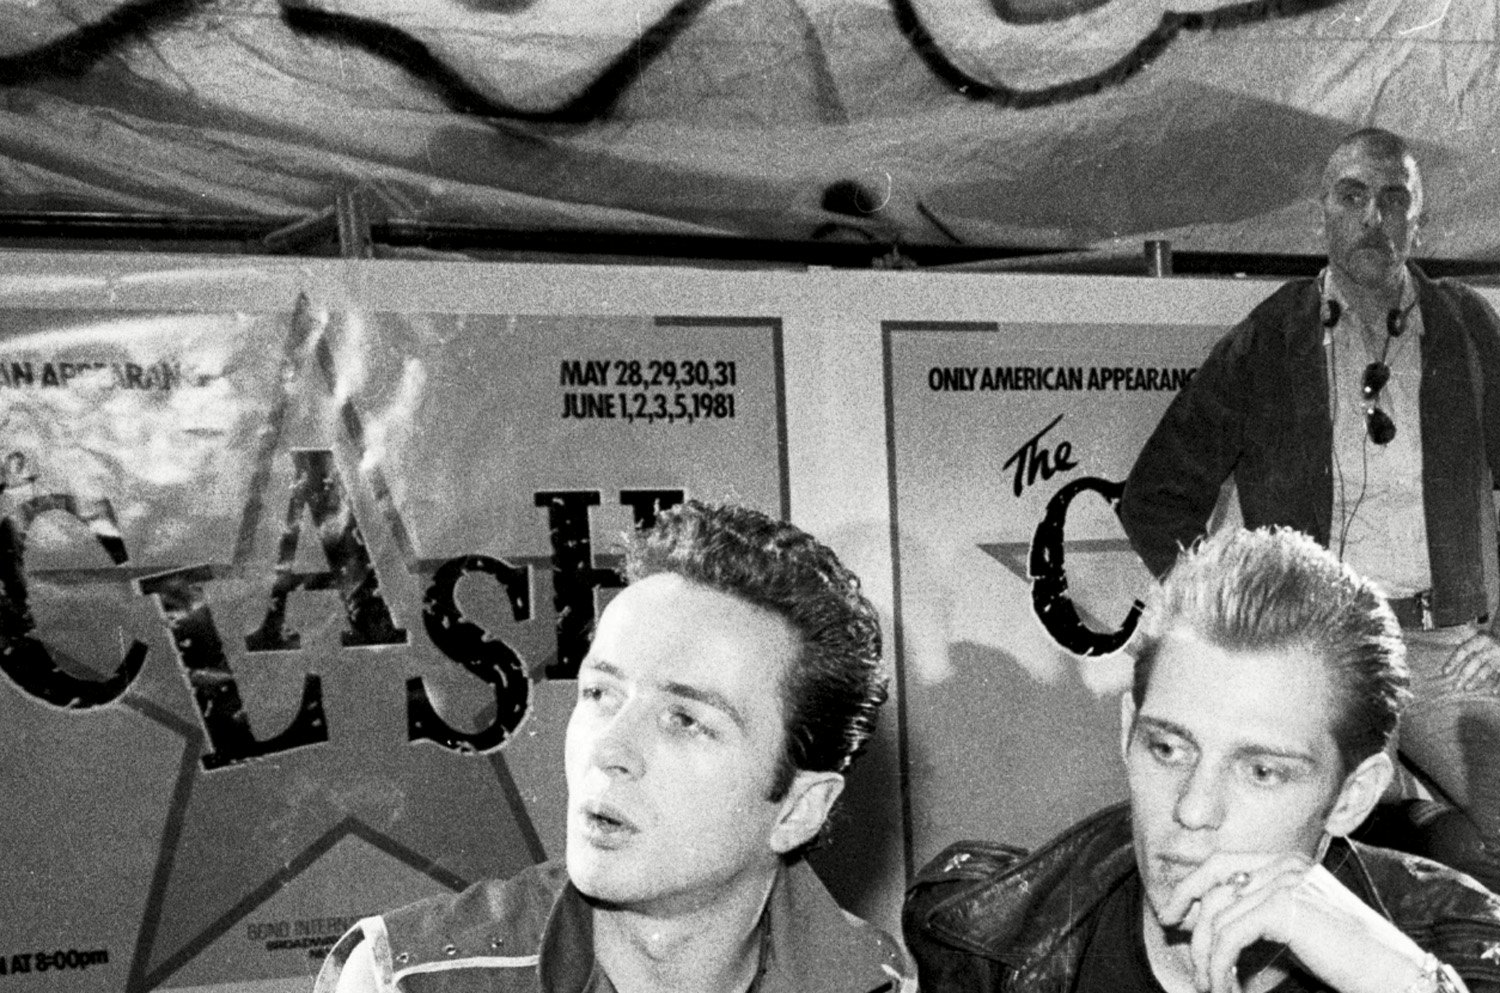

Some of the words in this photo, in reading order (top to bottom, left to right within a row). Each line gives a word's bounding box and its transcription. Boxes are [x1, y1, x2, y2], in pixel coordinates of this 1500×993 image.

[559, 360, 611, 387] MAY
[613, 360, 737, 390] 28,29,30,31
[928, 366, 978, 391] ONLY
[980, 366, 1084, 391] AMERICAN
[561, 393, 616, 419] JUNE
[618, 393, 736, 424] 1,2,3,5,1981
[1002, 412, 1079, 498] The
[11, 954, 32, 974] AT
